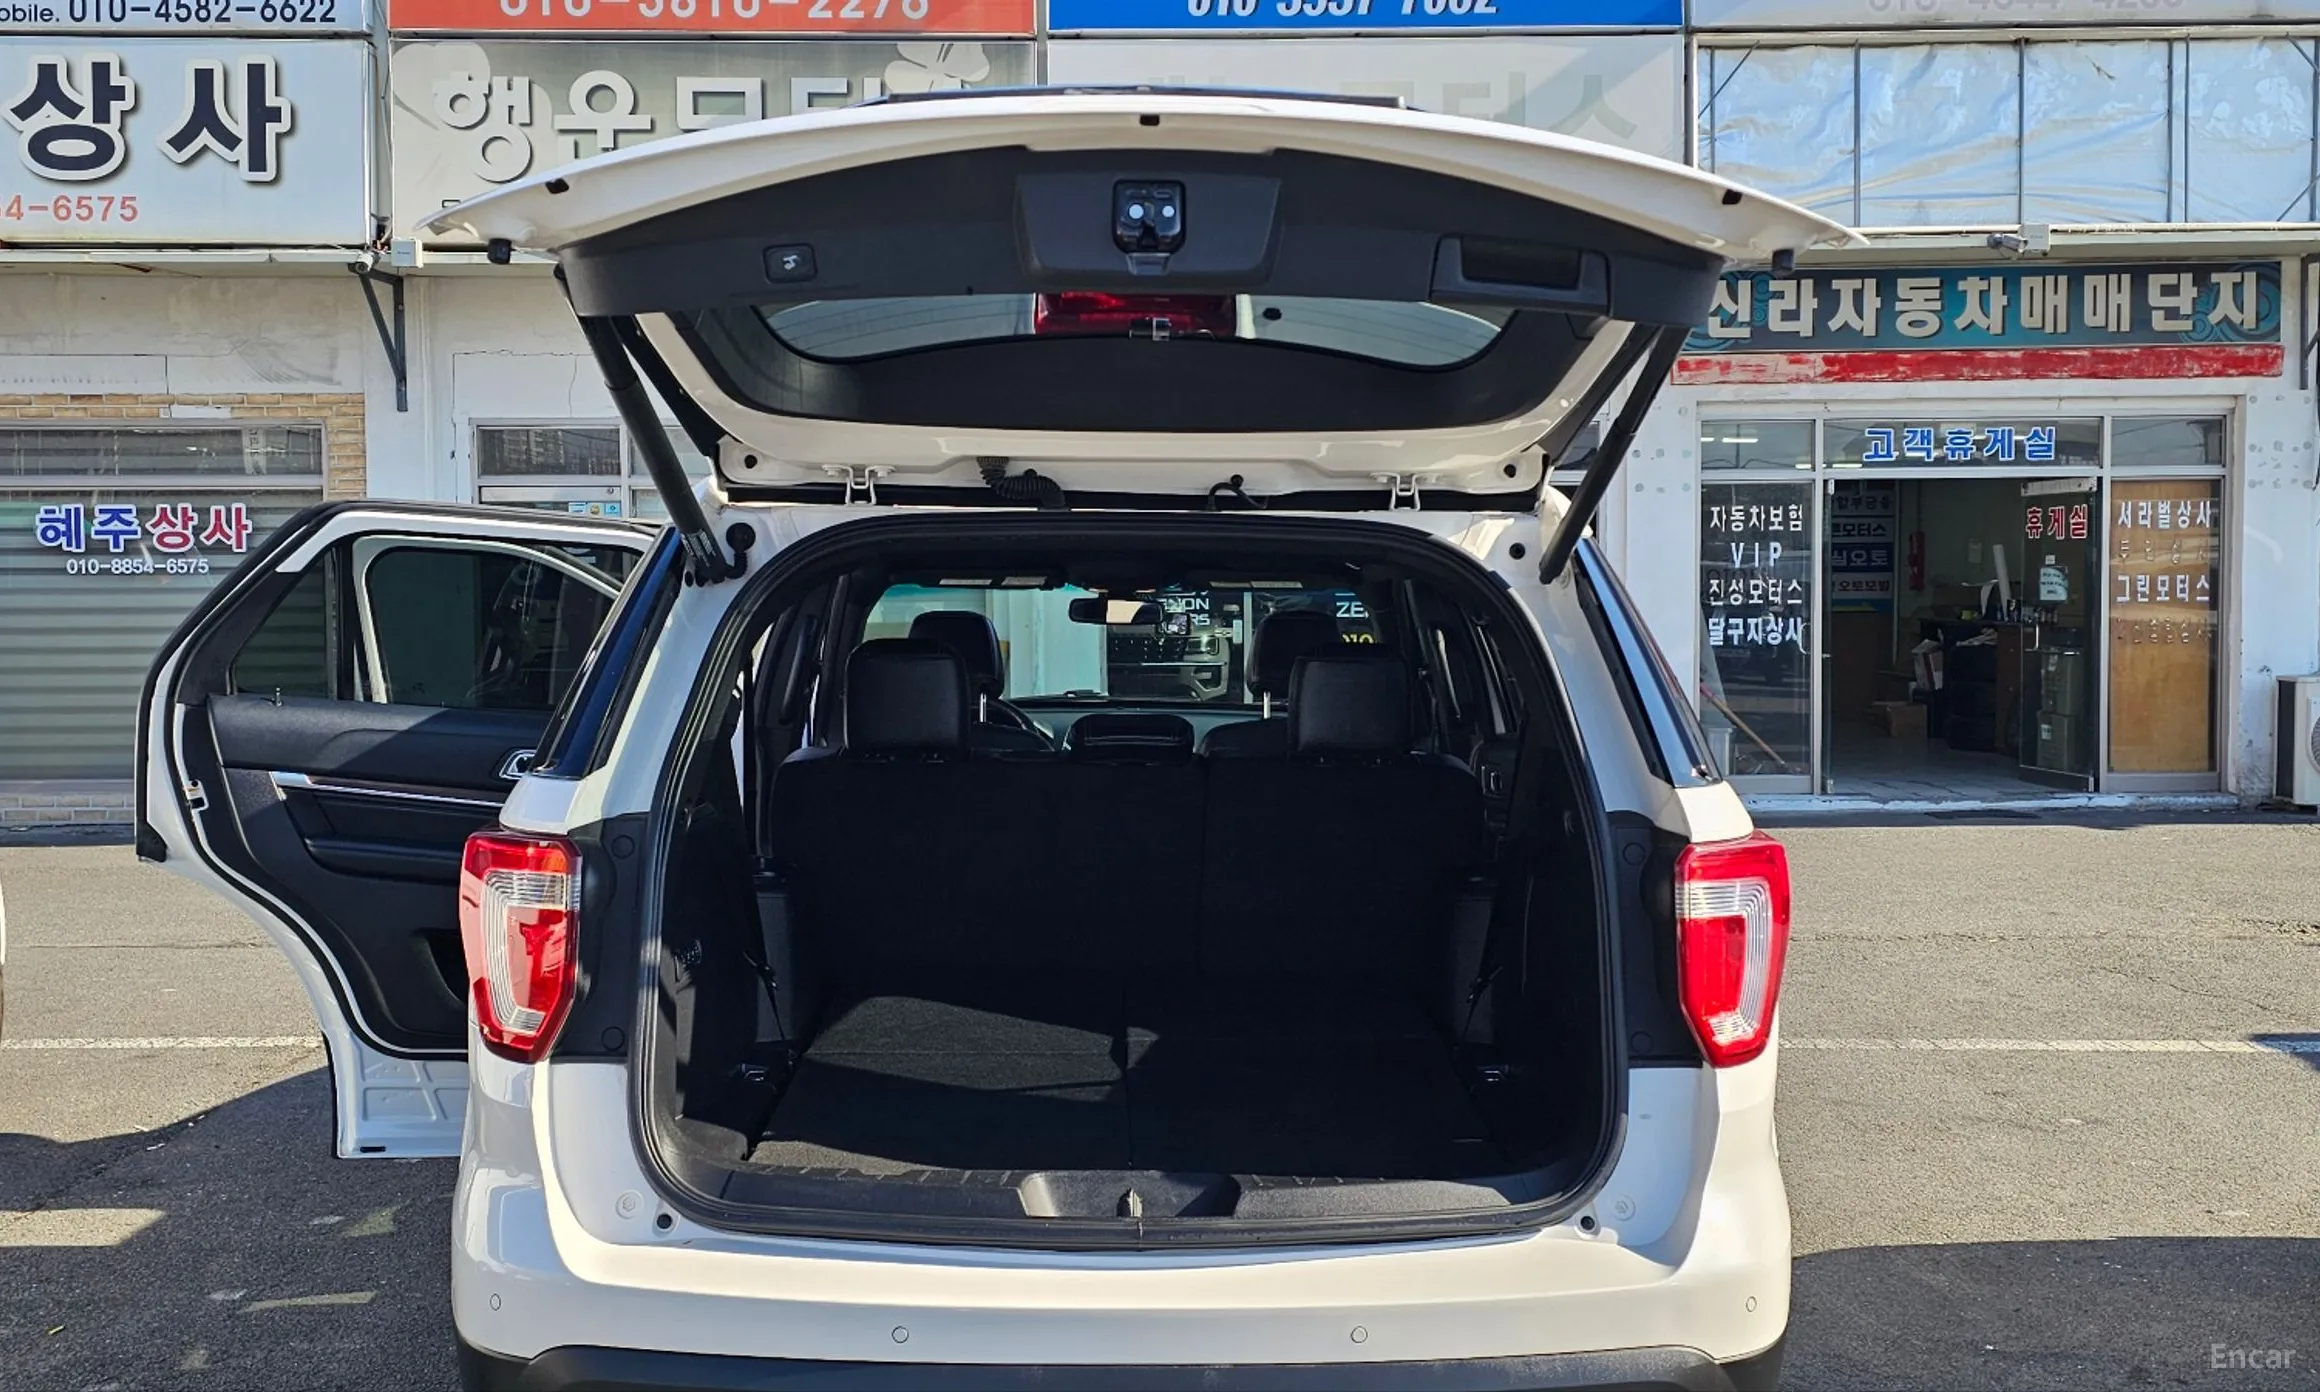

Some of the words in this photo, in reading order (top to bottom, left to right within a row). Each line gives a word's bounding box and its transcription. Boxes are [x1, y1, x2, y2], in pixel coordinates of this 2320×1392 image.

[68, 0, 337, 23] 010-4582-6622
[6, 57, 287, 180] 상사
[0, 194, 139, 222] 4-6575
[1864, 427, 2056, 461] 고객휴게실
[36, 502, 253, 553] 혜주상사
[1710, 504, 1803, 532] 자동차보험
[2025, 504, 2089, 540] 휴게실
[2118, 501, 2211, 529] 서라벌상사
[66, 558, 209, 575] 010-8854-6575
[1731, 542, 1782, 568] VIP
[1709, 578, 1803, 606] 진성모터스
[2117, 574, 2210, 602] 그린모터스
[1708, 614, 1804, 646] 달구지상사
